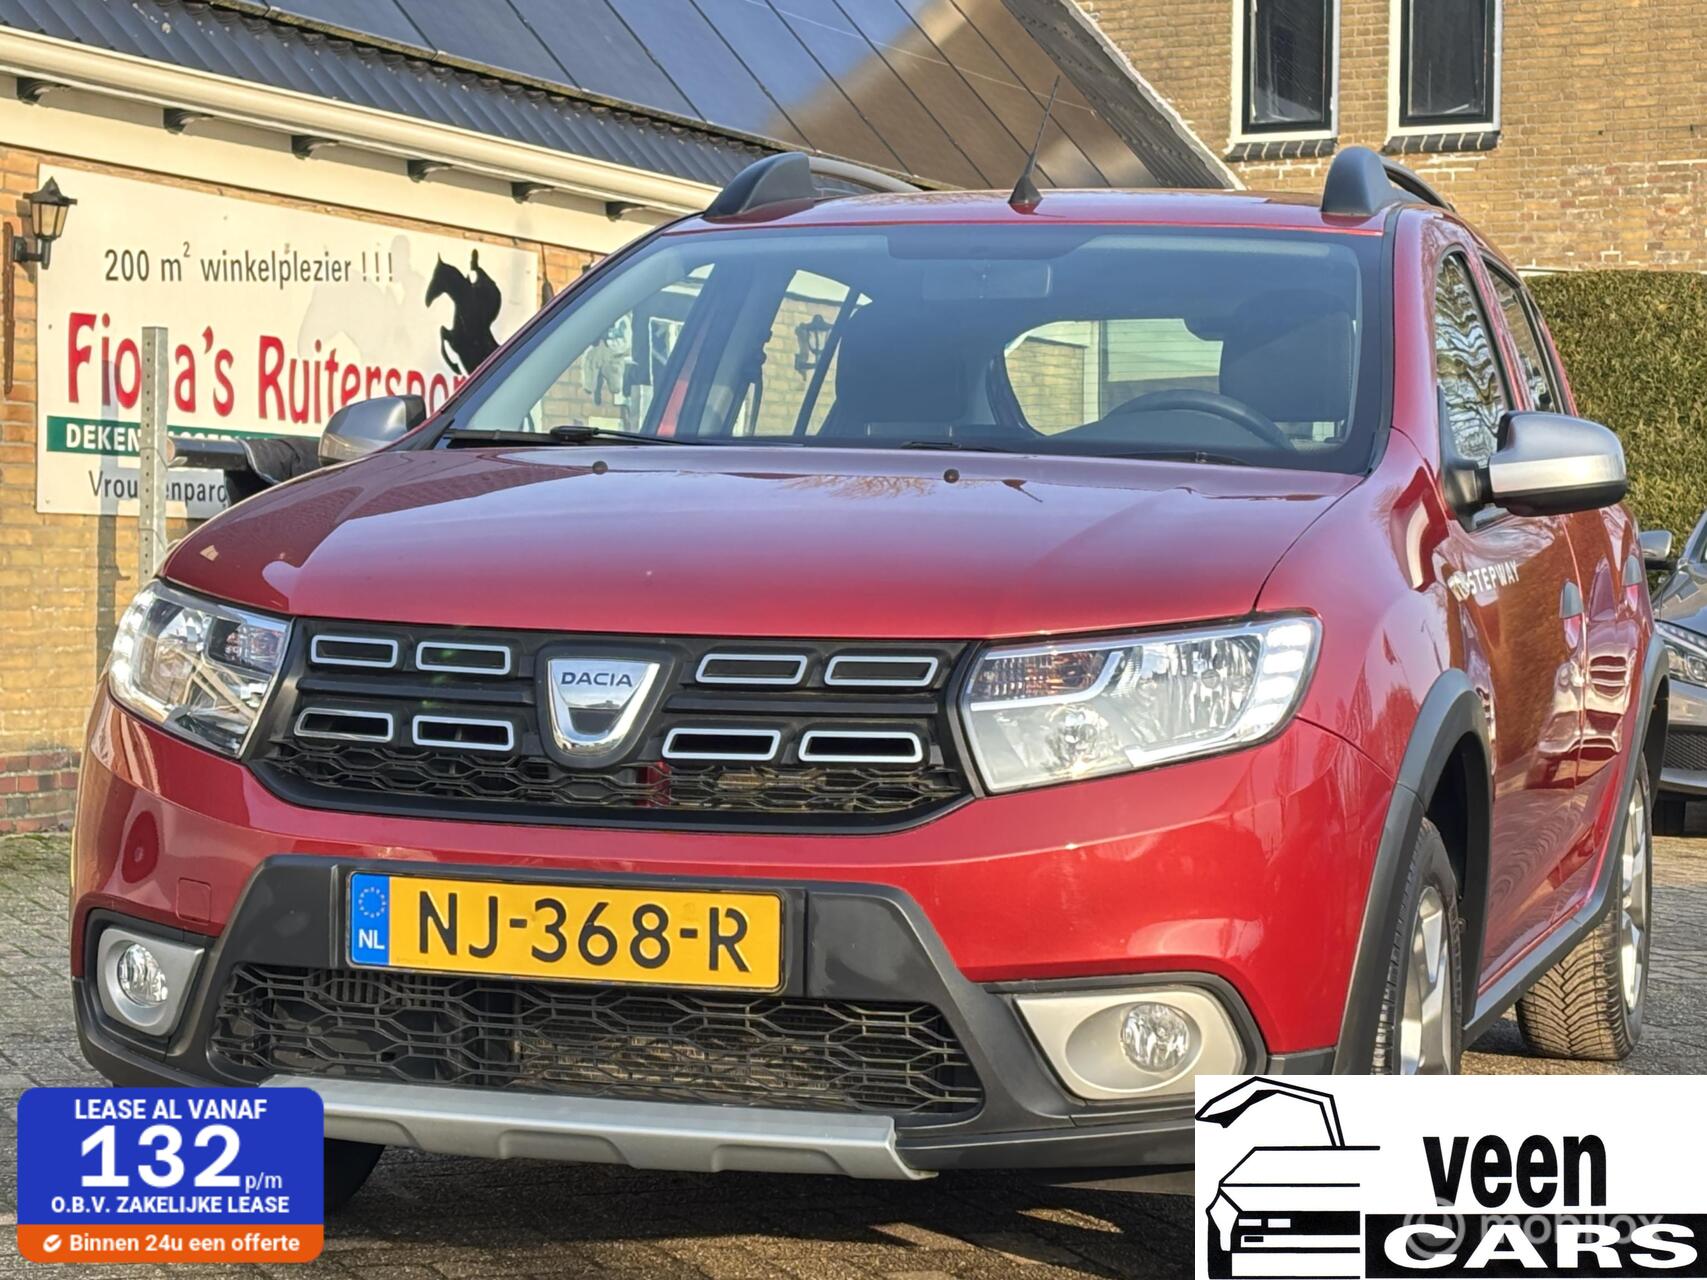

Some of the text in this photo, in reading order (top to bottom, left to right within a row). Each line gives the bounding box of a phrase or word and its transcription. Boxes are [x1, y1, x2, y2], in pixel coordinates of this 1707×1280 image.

[105, 249, 150, 281] 200
[200, 250, 351, 290] winkelplezier
[68, 312, 235, 417] Fioa's
[1467, 560, 1520, 595] STEPWAY
[561, 672, 633, 687] DACIA
[358, 928, 385, 950] NL
[419, 890, 750, 972] NJ-368-R
